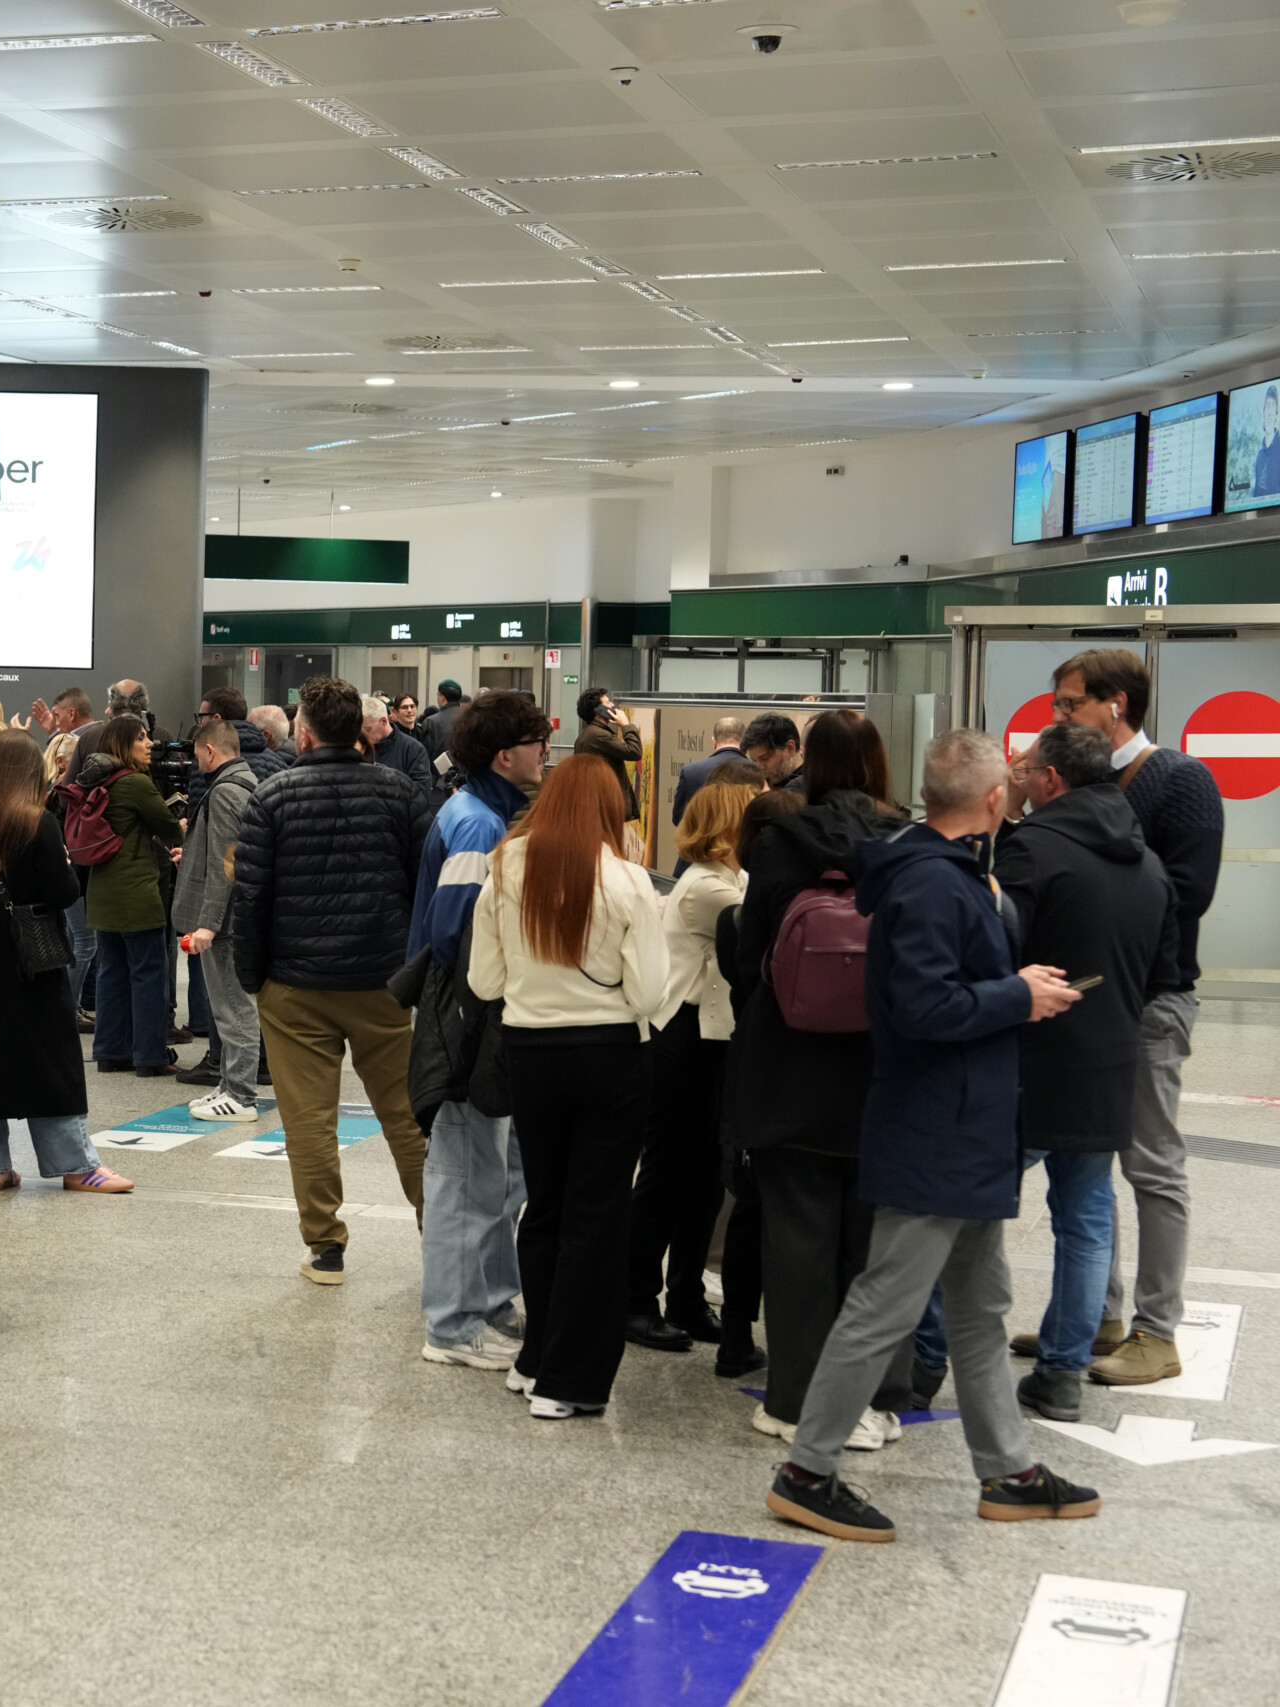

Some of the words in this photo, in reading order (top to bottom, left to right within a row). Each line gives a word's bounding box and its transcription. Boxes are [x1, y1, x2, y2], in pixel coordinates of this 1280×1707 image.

[1124, 568, 1148, 592] Arrivi
[677, 729, 686, 750] The
[687, 729, 698, 752] best
[698, 730, 705, 752] of
[697, 1562, 763, 1579] TAXI
